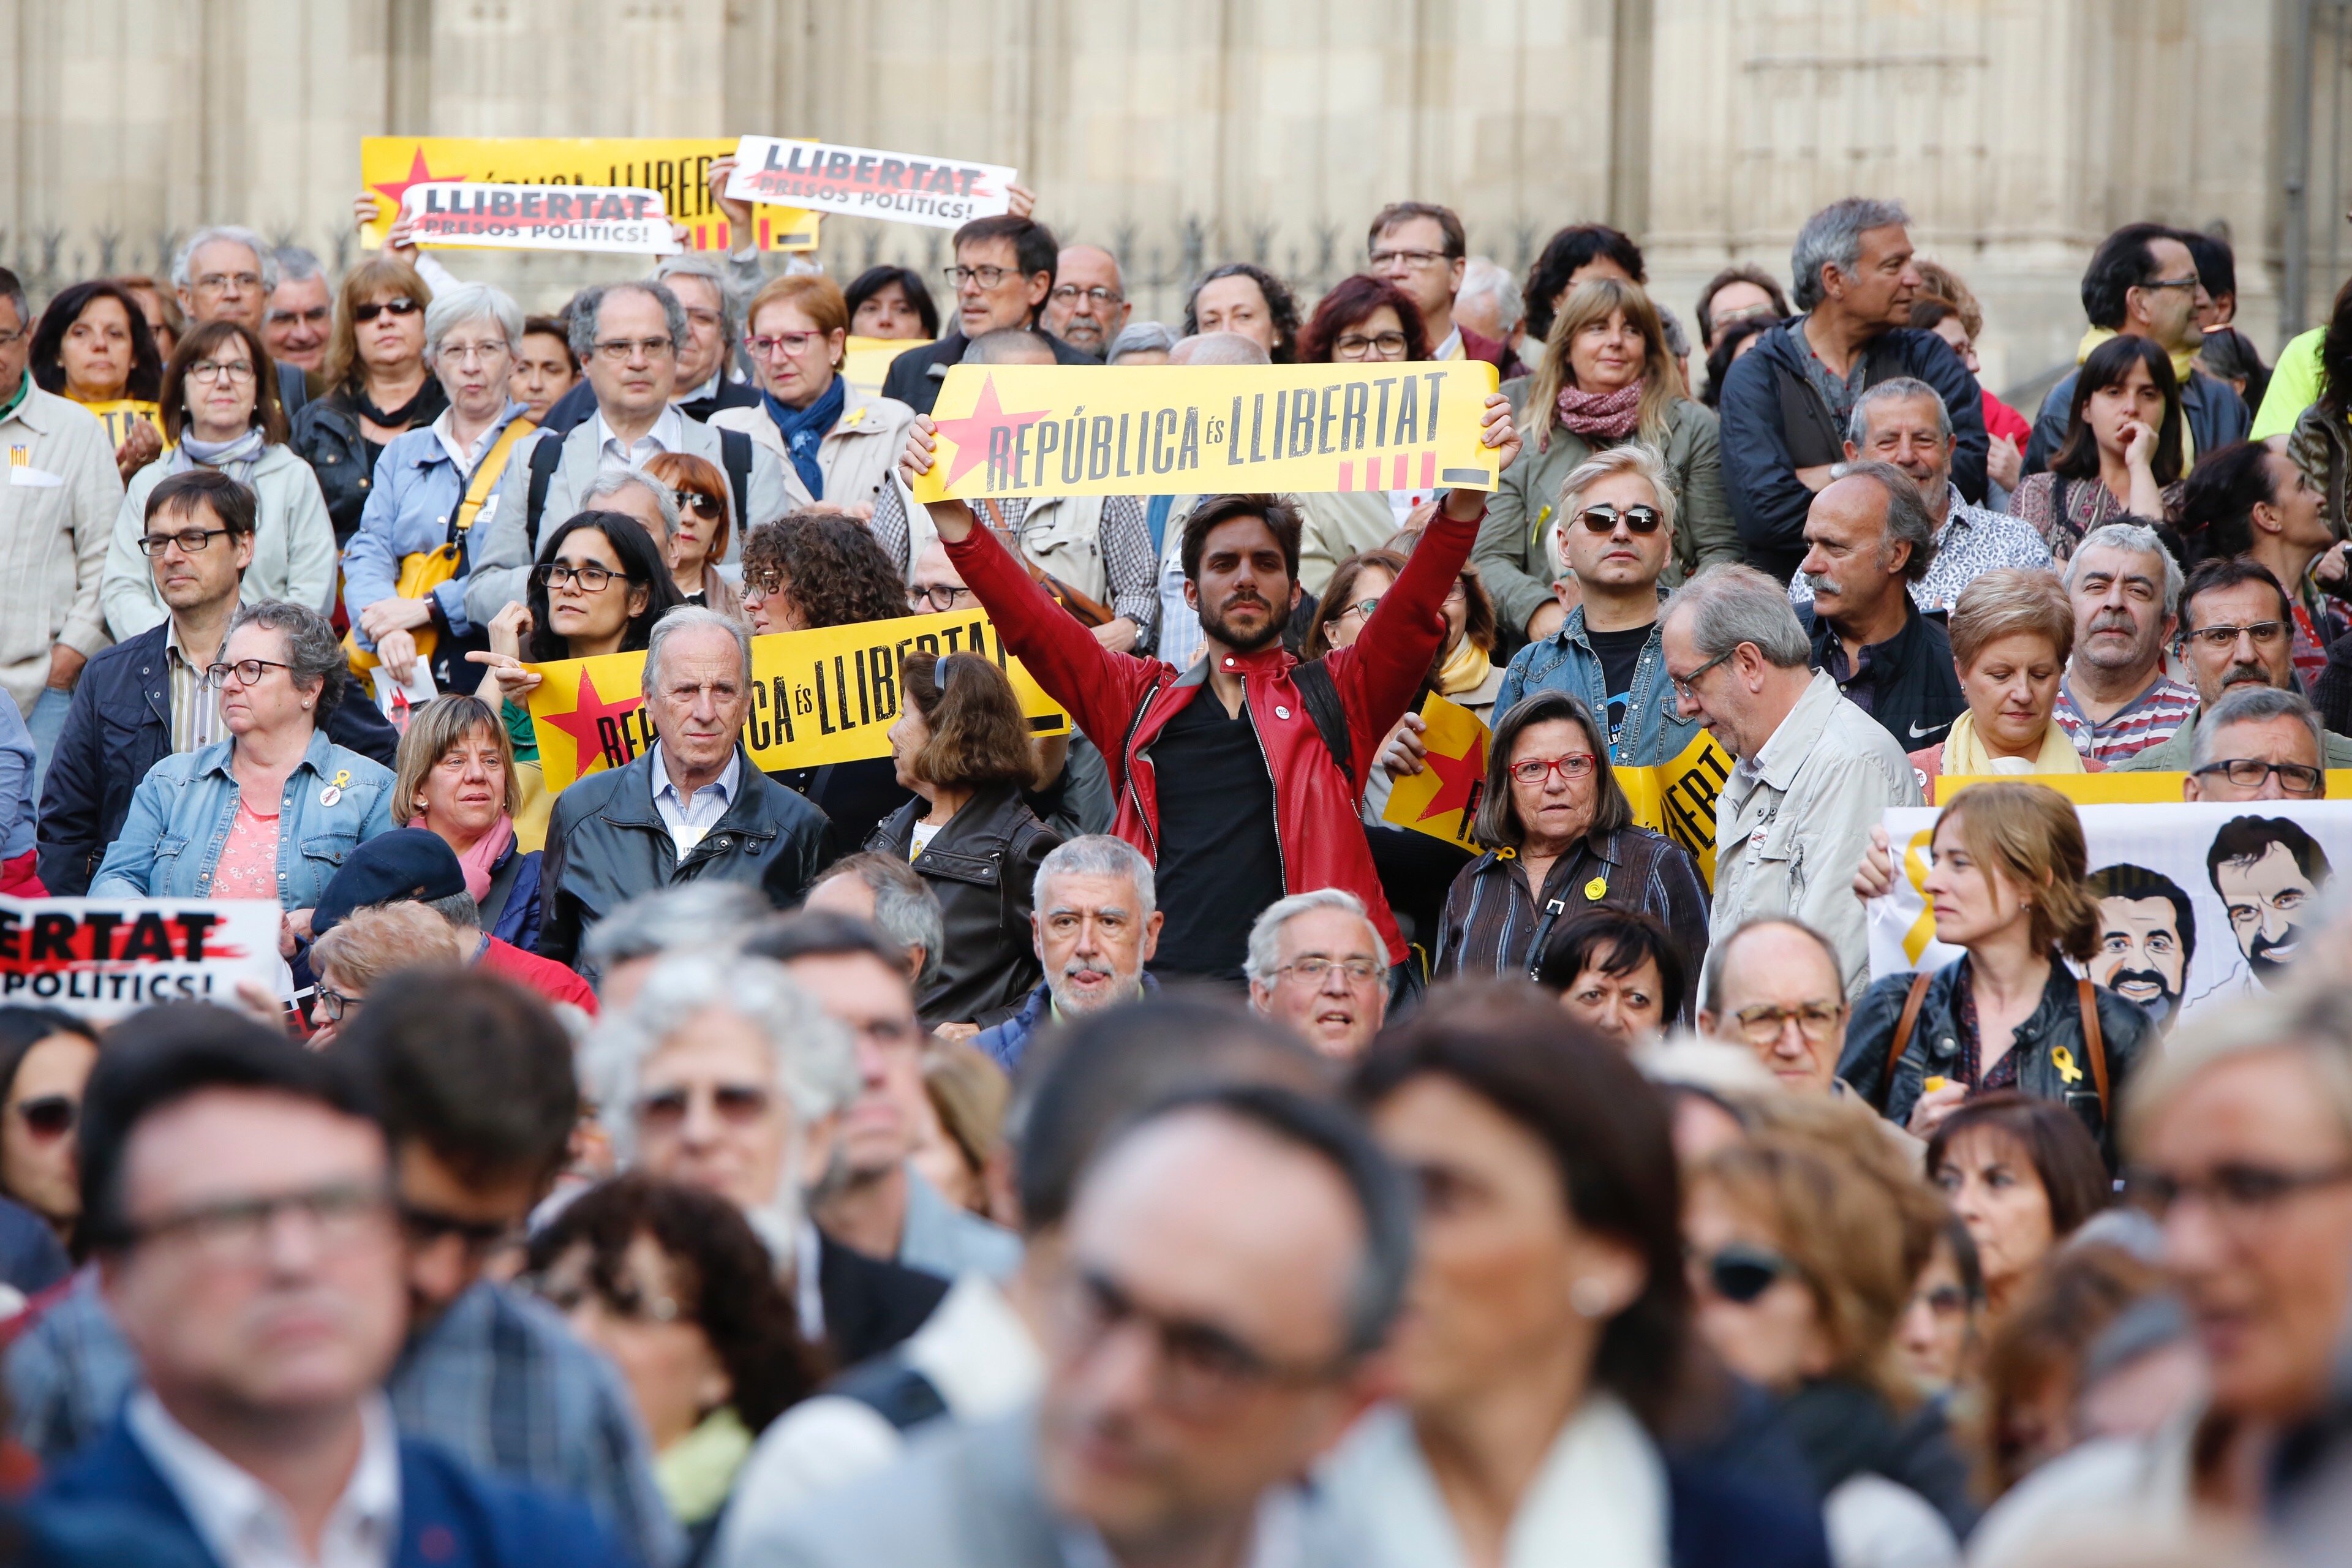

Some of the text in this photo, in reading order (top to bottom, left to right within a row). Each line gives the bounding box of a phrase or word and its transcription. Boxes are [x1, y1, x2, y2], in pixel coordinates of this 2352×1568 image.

[764, 145, 981, 197] LLIBERTAT
[426, 189, 650, 221] LLIBERTAT
[759, 176, 850, 203] PRESOS
[425, 219, 519, 238] PRESOS
[986, 371, 1448, 492] REPÚBLICA ÉS LLIBERTAT
[795, 684, 813, 716] ÉS
